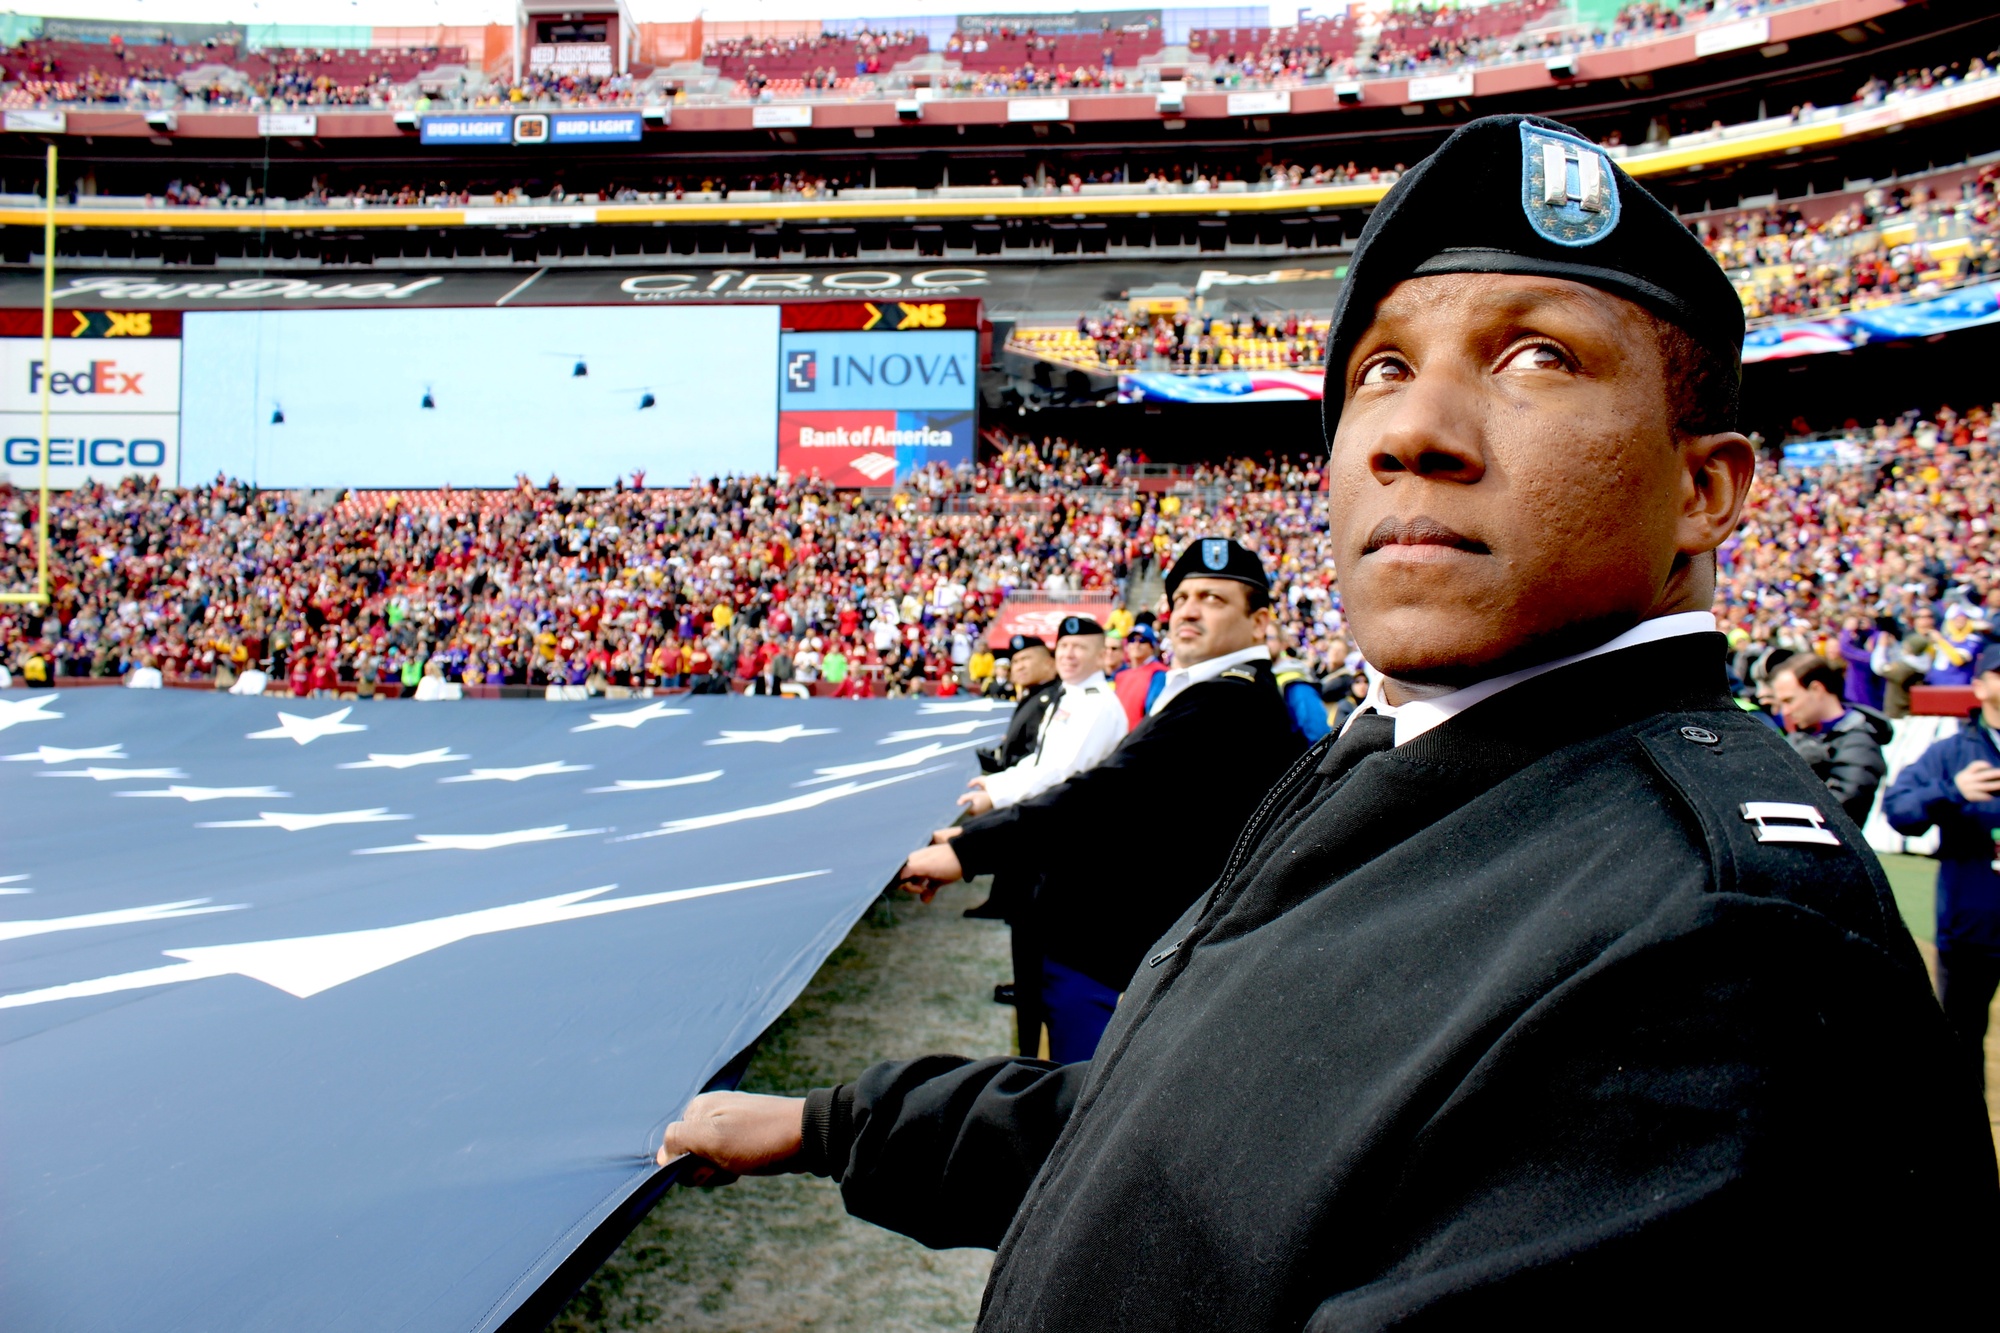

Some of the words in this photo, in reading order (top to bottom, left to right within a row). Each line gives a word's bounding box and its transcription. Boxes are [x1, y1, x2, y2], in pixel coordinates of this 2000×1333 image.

[427, 122, 458, 137] BUD
[460, 121, 505, 136] LIGHT
[556, 120, 589, 136] BUD
[590, 119, 635, 135] LIGHT
[52, 276, 443, 299] FanDuel
[724, 287, 858, 299] PREMIUM
[864, 285, 962, 298] VODKA
[29, 360, 144, 395] FedEx
[831, 353, 966, 386] INOVA
[800, 426, 850, 447] Bank
[850, 425, 871, 447] of
[871, 425, 953, 446] America
[4, 438, 166, 467] GEICO
